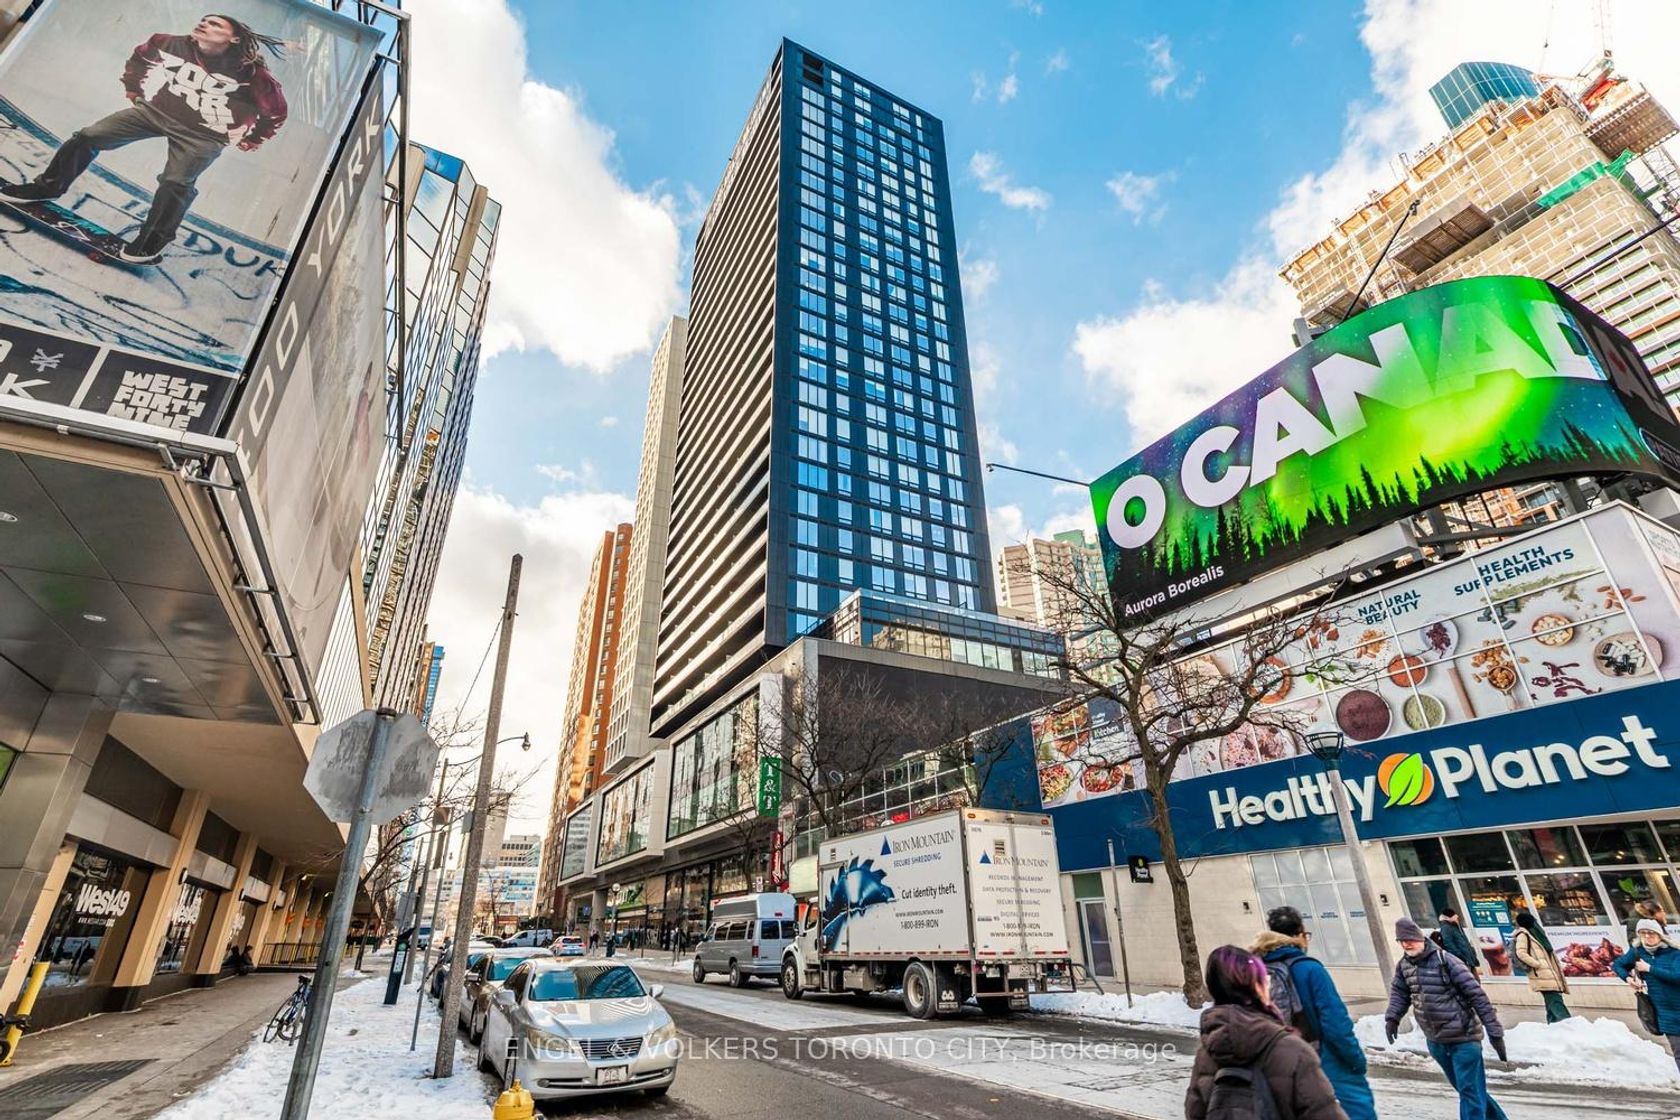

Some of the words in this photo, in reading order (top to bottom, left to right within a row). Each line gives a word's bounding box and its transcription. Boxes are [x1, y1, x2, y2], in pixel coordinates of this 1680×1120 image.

[307, 94, 380, 278] YORK
[121, 370, 208, 401] WEST
[113, 386, 206, 418] FORTY
[1106, 475, 1166, 549] O
[1454, 549, 1575, 596] SUPPLEMENTS
[1478, 546, 1545, 576] HEALTH
[1125, 591, 1166, 617] Aurora
[1168, 565, 1224, 598] Borealis
[1358, 589, 1421, 617] NATURAL
[1208, 771, 1376, 829] Healthy
[1431, 715, 1671, 798] Planet
[911, 830, 954, 850] MOUNTAIN
[893, 857, 910, 867] SECURE
[911, 852, 942, 865] SHREDDING
[902, 888, 912, 899] Cut
[913, 886, 937, 899] identity
[938, 882, 957, 895] theft.
[1002, 922, 1041, 930] 1-800-89-IRON
